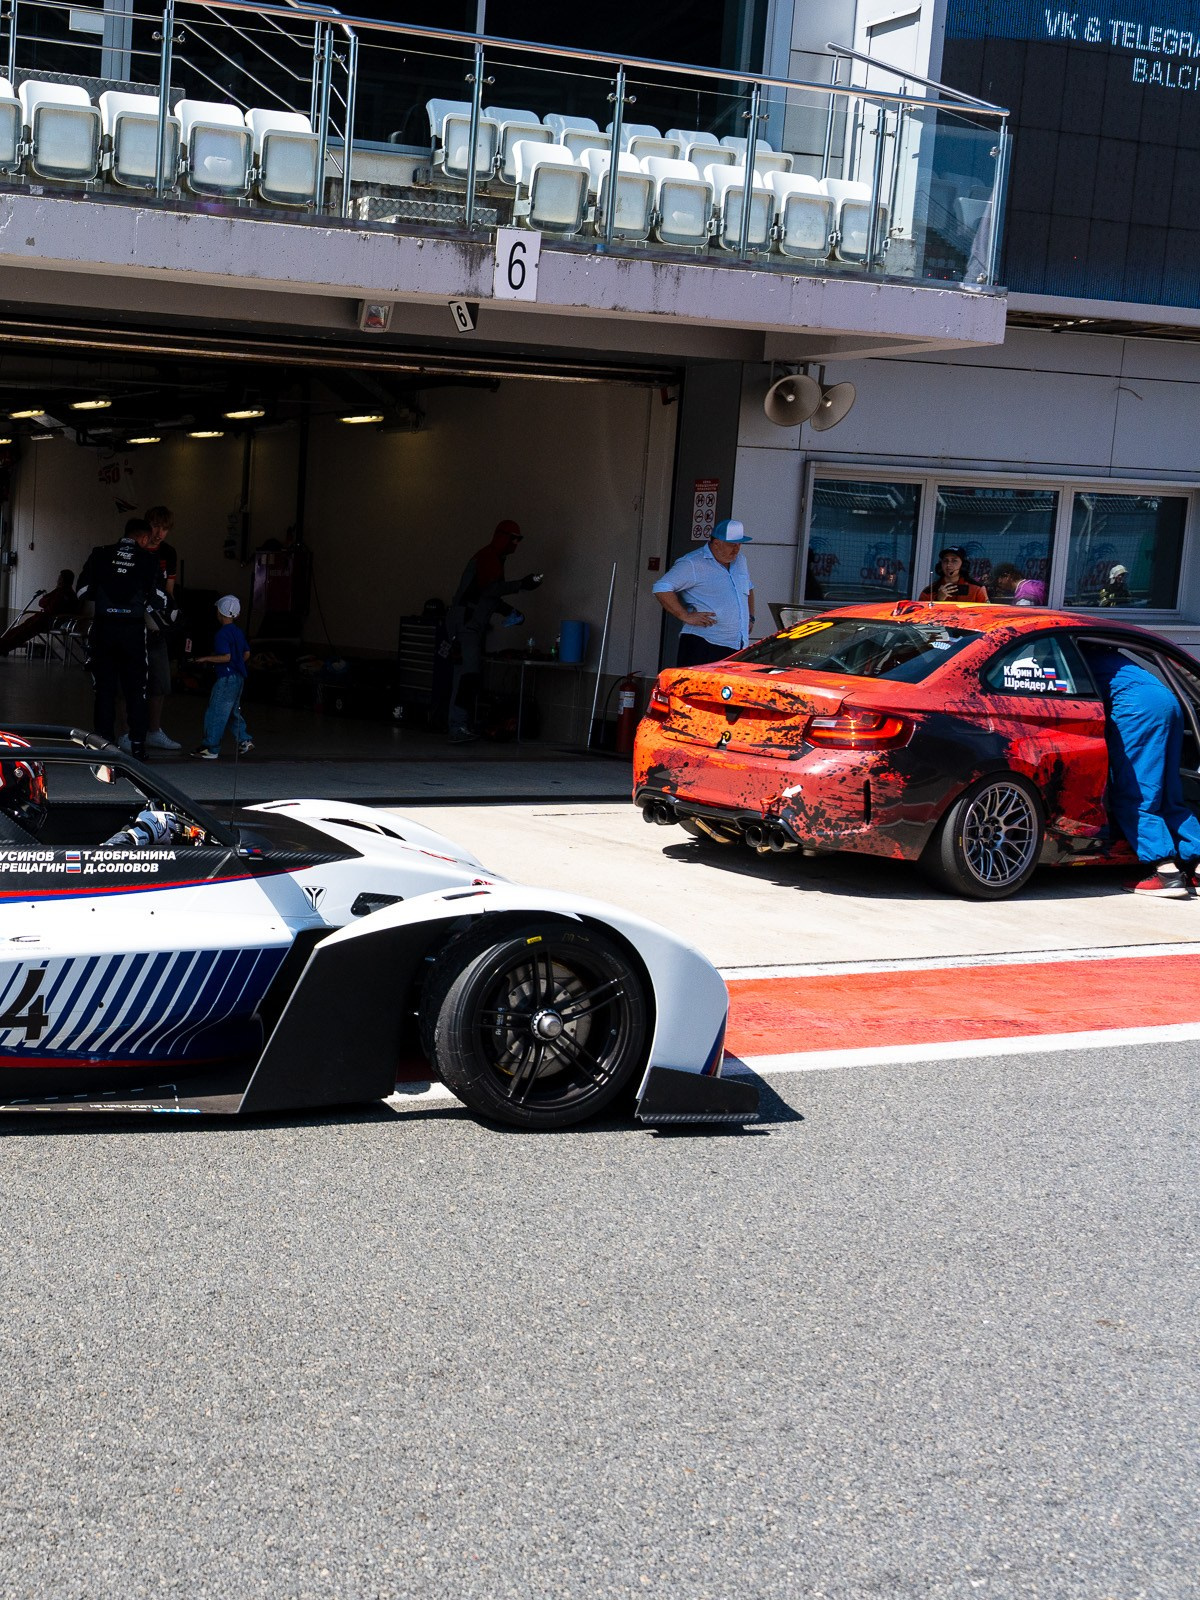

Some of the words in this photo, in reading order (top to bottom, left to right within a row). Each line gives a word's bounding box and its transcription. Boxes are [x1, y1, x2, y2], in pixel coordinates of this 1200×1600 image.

[1045, 9, 1078, 40] VK
[507, 241, 527, 291] 6
[456, 305, 468, 328] 6
[1004, 677, 1046, 692] Шрейдер
[1047, 680, 1057, 692] А.
[83, 850, 177, 862] Т.ДОБРЫНИНА
[83, 863, 159, 874] Д.СОЛОВОВ
